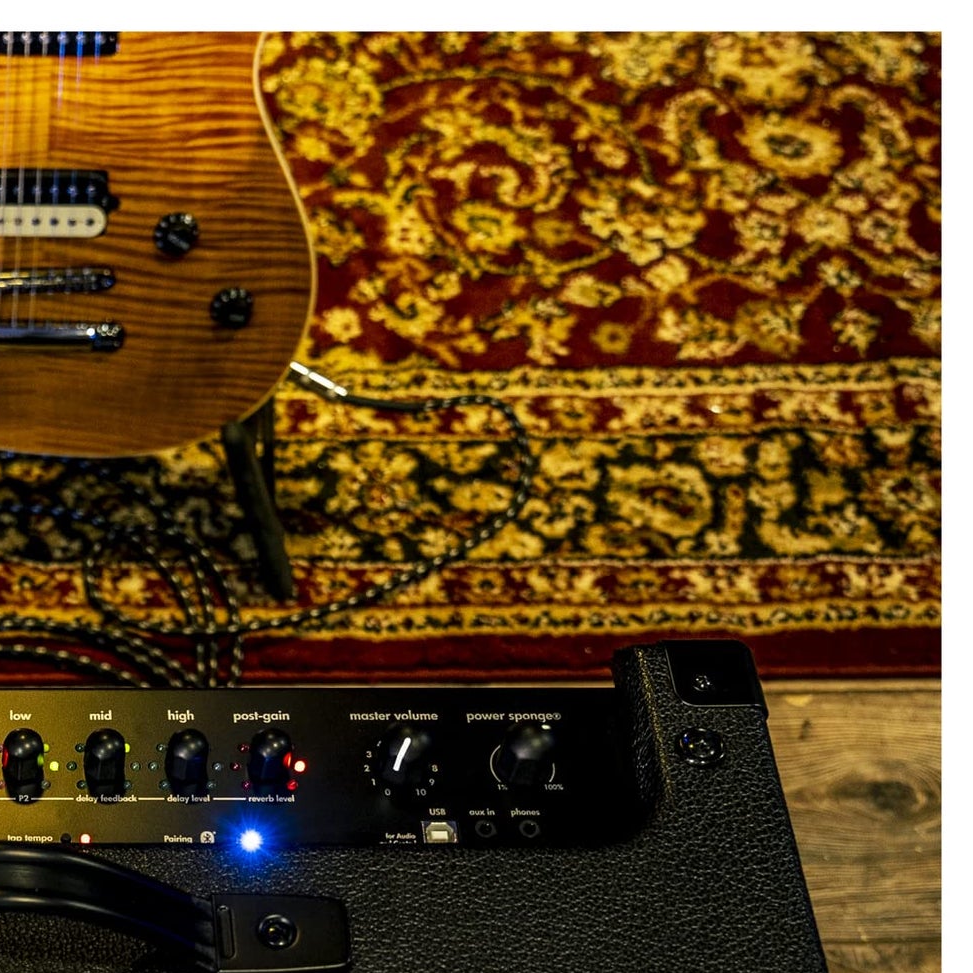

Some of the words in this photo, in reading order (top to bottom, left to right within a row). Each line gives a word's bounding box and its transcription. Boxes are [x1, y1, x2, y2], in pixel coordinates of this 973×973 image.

[9, 710, 32, 721] low
[89, 710, 113, 721] mid
[167, 710, 195, 724] high
[233, 710, 290, 724] post-gain
[349, 711, 391, 721] master
[393, 710, 438, 721] volume
[466, 712, 505, 723] power
[366, 750, 372, 758] 3
[364, 764, 370, 772] 2
[431, 764, 438, 772] 8
[371, 778, 376, 786] 1
[429, 778, 435, 786] 9
[384, 788, 391, 796] 0
[415, 788, 427, 796] 10
[76, 794, 98, 803] delay
[100, 794, 137, 802] feedback
[167, 794, 190, 803] delay
[191, 794, 211, 802] level
[248, 794, 274, 802] reverb
[276, 794, 295, 802] level
[510, 808, 540, 816] phones
[25, 834, 53, 842] tempo
[163, 835, 193, 843] Pairing
